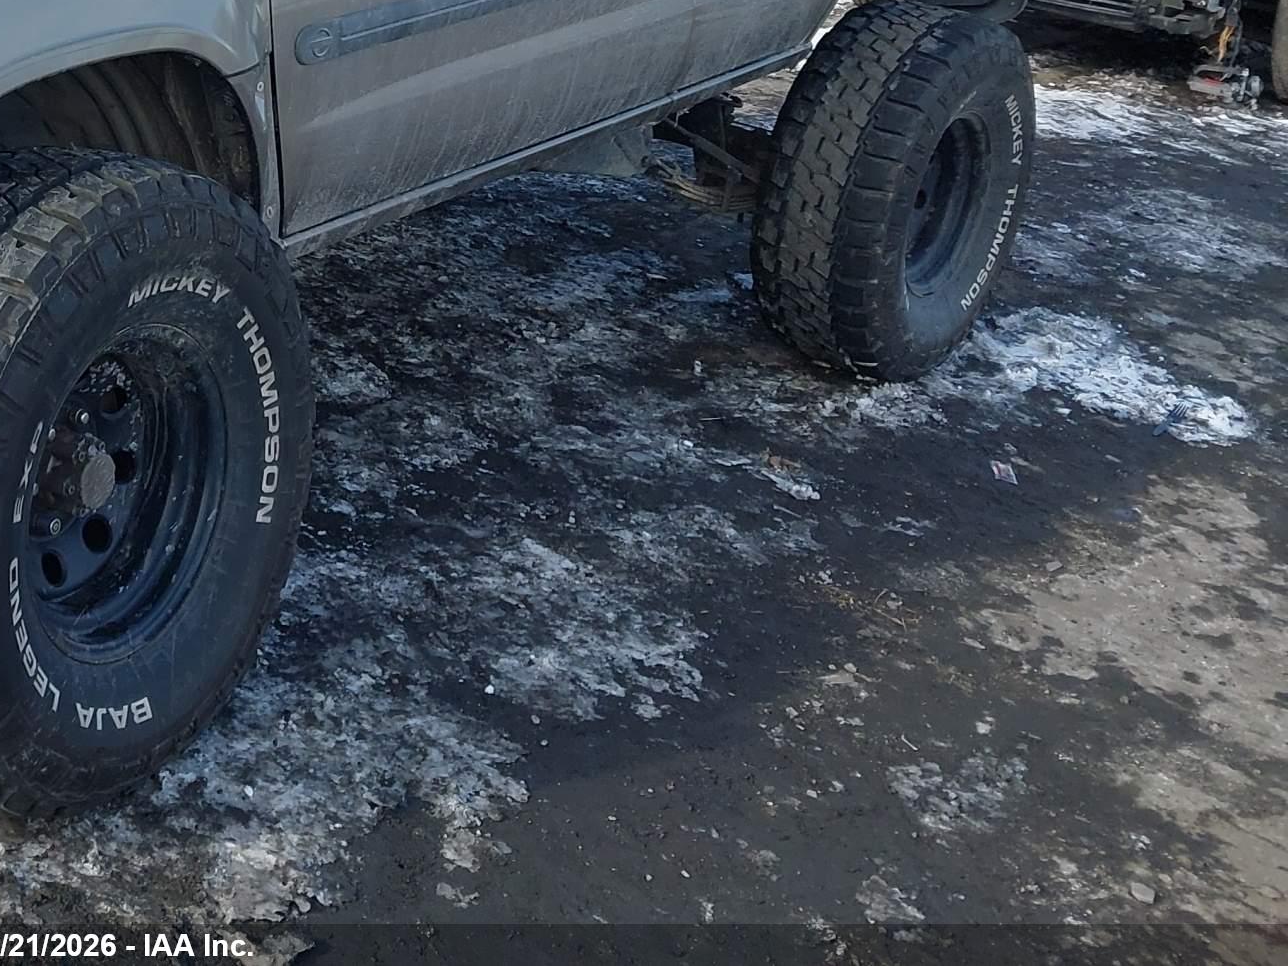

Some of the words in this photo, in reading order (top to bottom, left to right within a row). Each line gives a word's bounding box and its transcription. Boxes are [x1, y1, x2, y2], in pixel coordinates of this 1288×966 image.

[1004, 95, 1022, 166] MICKEY
[960, 184, 1019, 312] THOMPSON
[127, 275, 231, 308] MICKEY
[236, 306, 280, 524] THOMPSON
[9, 557, 60, 713] LEGEND
[75, 696, 153, 731] BAJA
